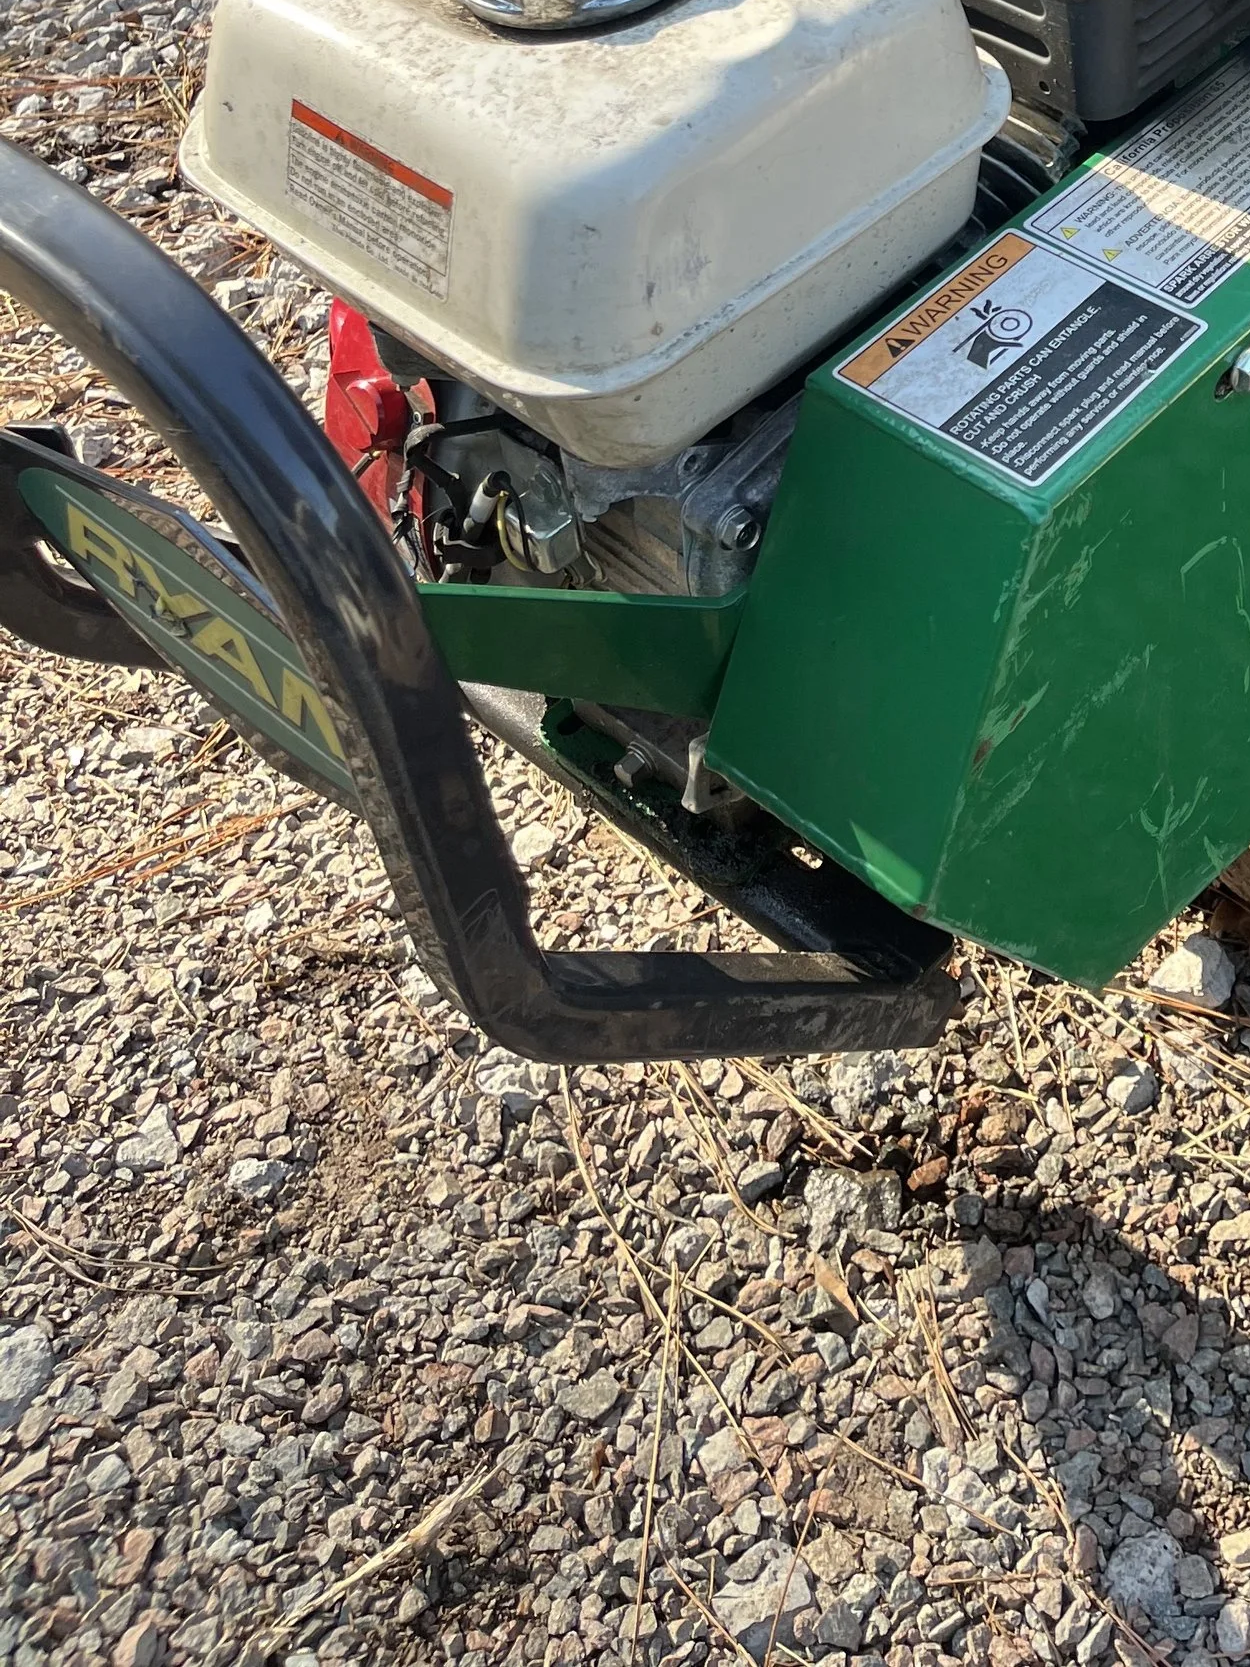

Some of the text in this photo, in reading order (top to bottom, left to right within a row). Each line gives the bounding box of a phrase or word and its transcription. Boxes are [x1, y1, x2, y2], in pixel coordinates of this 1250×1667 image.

[1101, 135, 1158, 177] California
[1151, 90, 1214, 137] Proposition
[1207, 79, 1226, 92] 65
[1073, 189, 1119, 224] WARNING:
[1083, 215, 1102, 228] lead
[1097, 205, 1114, 217] and
[1092, 216, 1116, 233] which
[1112, 207, 1127, 218] are
[1102, 222, 1123, 238] other
[1174, 168, 1189, 179] For
[1186, 156, 1205, 169] more
[1122, 198, 1184, 247] ADVERTENCIA:
[899, 251, 1011, 338] WARNING
[1161, 264, 1198, 293] SPARK
[1191, 225, 1244, 267] ARRESTOR
[948, 303, 1103, 435] ROTATING PARTS CAN ENTANGLE,
[960, 372, 1043, 442] CUT AND CRUSH
[976, 326, 1119, 451] -Keep hands away from moving parts.
[987, 313, 1149, 456] -Do not operate without guards and shield in
[1009, 424, 1062, 469] -Disconnect
[1054, 404, 1084, 428] spark
[1076, 389, 1101, 409] plug
[1093, 375, 1115, 392] and
[1108, 359, 1132, 378] read
[1125, 334, 1158, 362] manual
[1151, 314, 1180, 338] before
[999, 438, 1030, 463] place.
[1021, 387, 1120, 477] performing any service or
